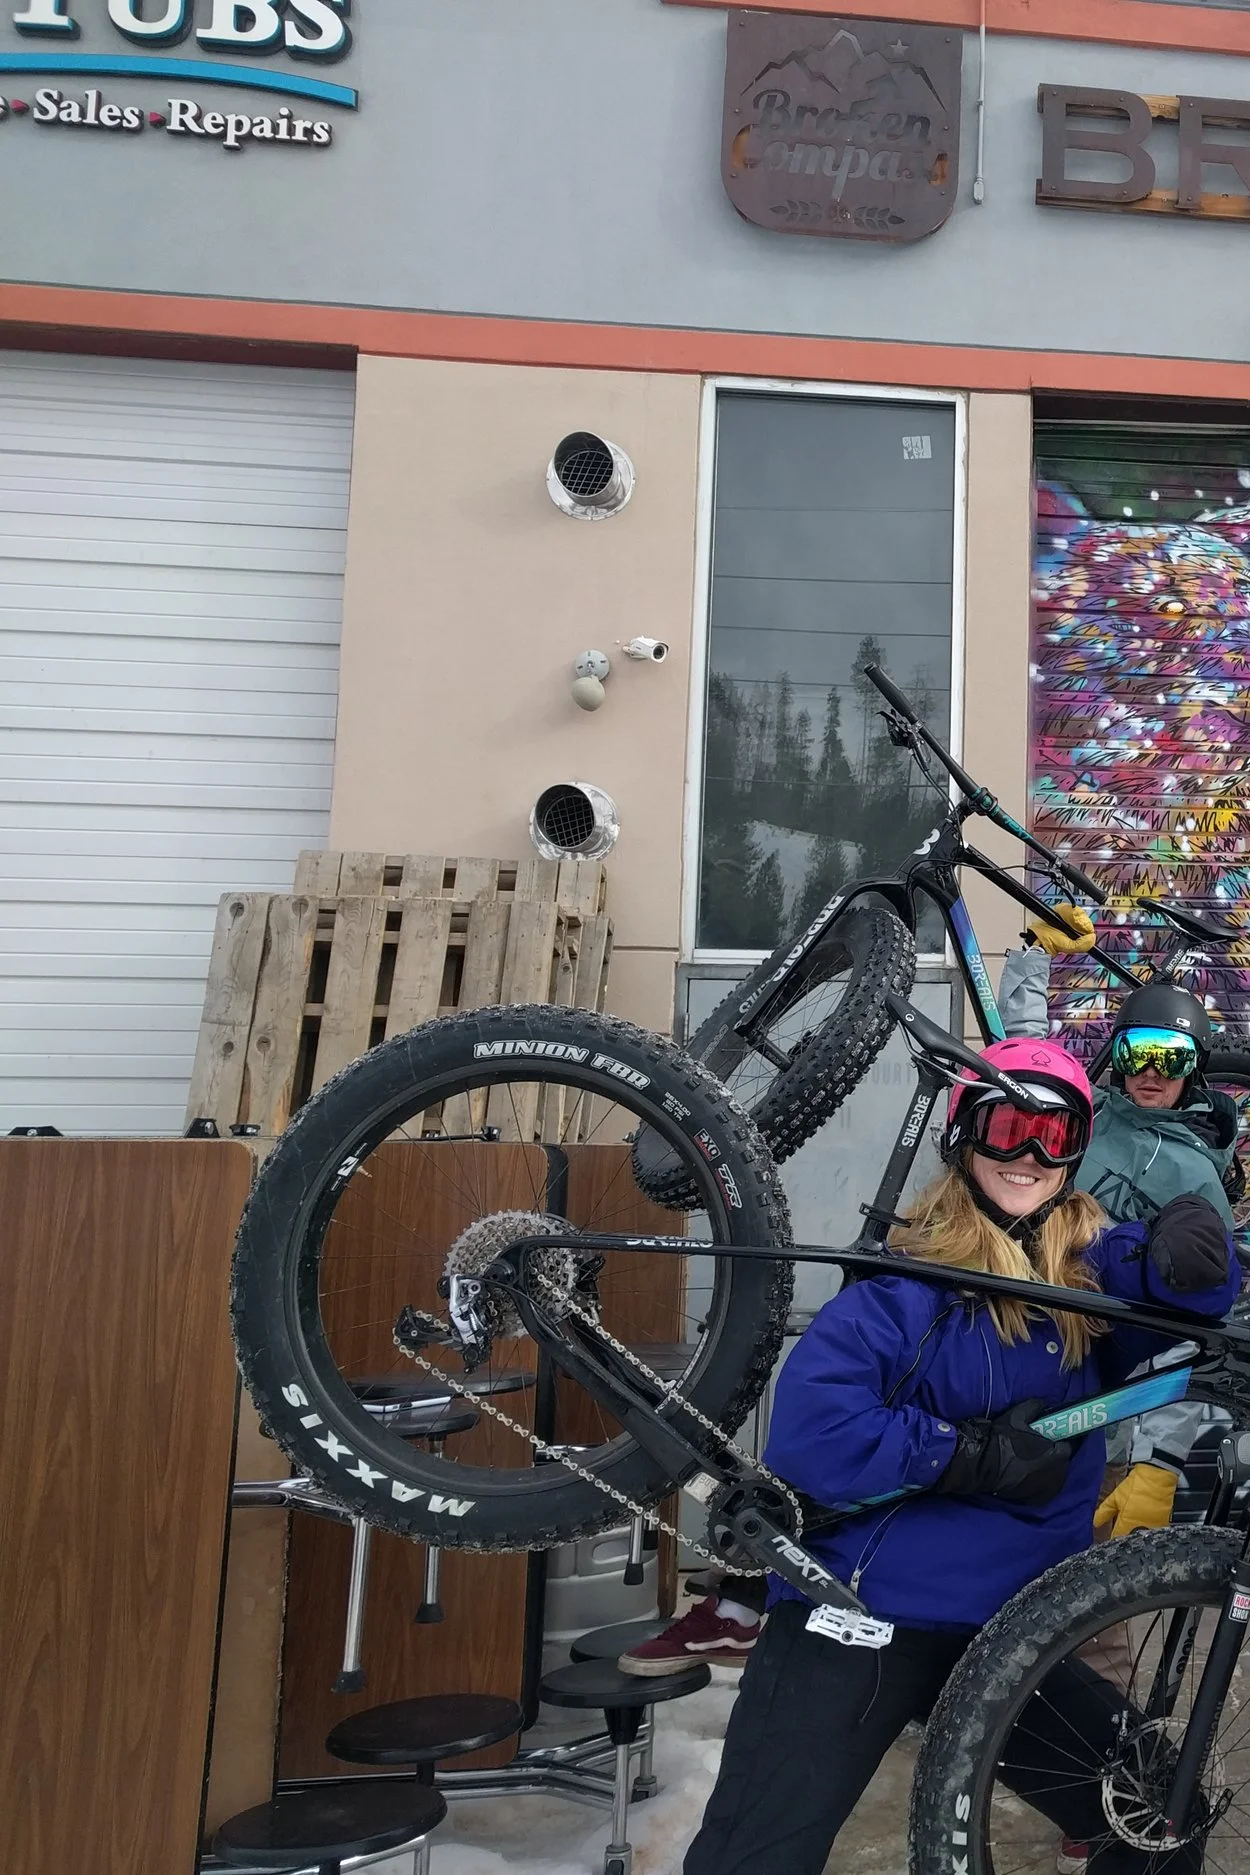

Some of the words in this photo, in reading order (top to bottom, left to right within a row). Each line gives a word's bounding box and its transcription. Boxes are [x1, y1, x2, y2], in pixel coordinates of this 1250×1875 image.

[33, 88, 142, 129] Sales
[166, 98, 332, 150] Repairs
[474, 1040, 590, 1063] MINION
[590, 1053, 651, 1091] FBR
[998, 1072, 1029, 1100] ERGON
[699, 1131, 720, 1159] EXO
[281, 1383, 476, 1517] MAXXIS
